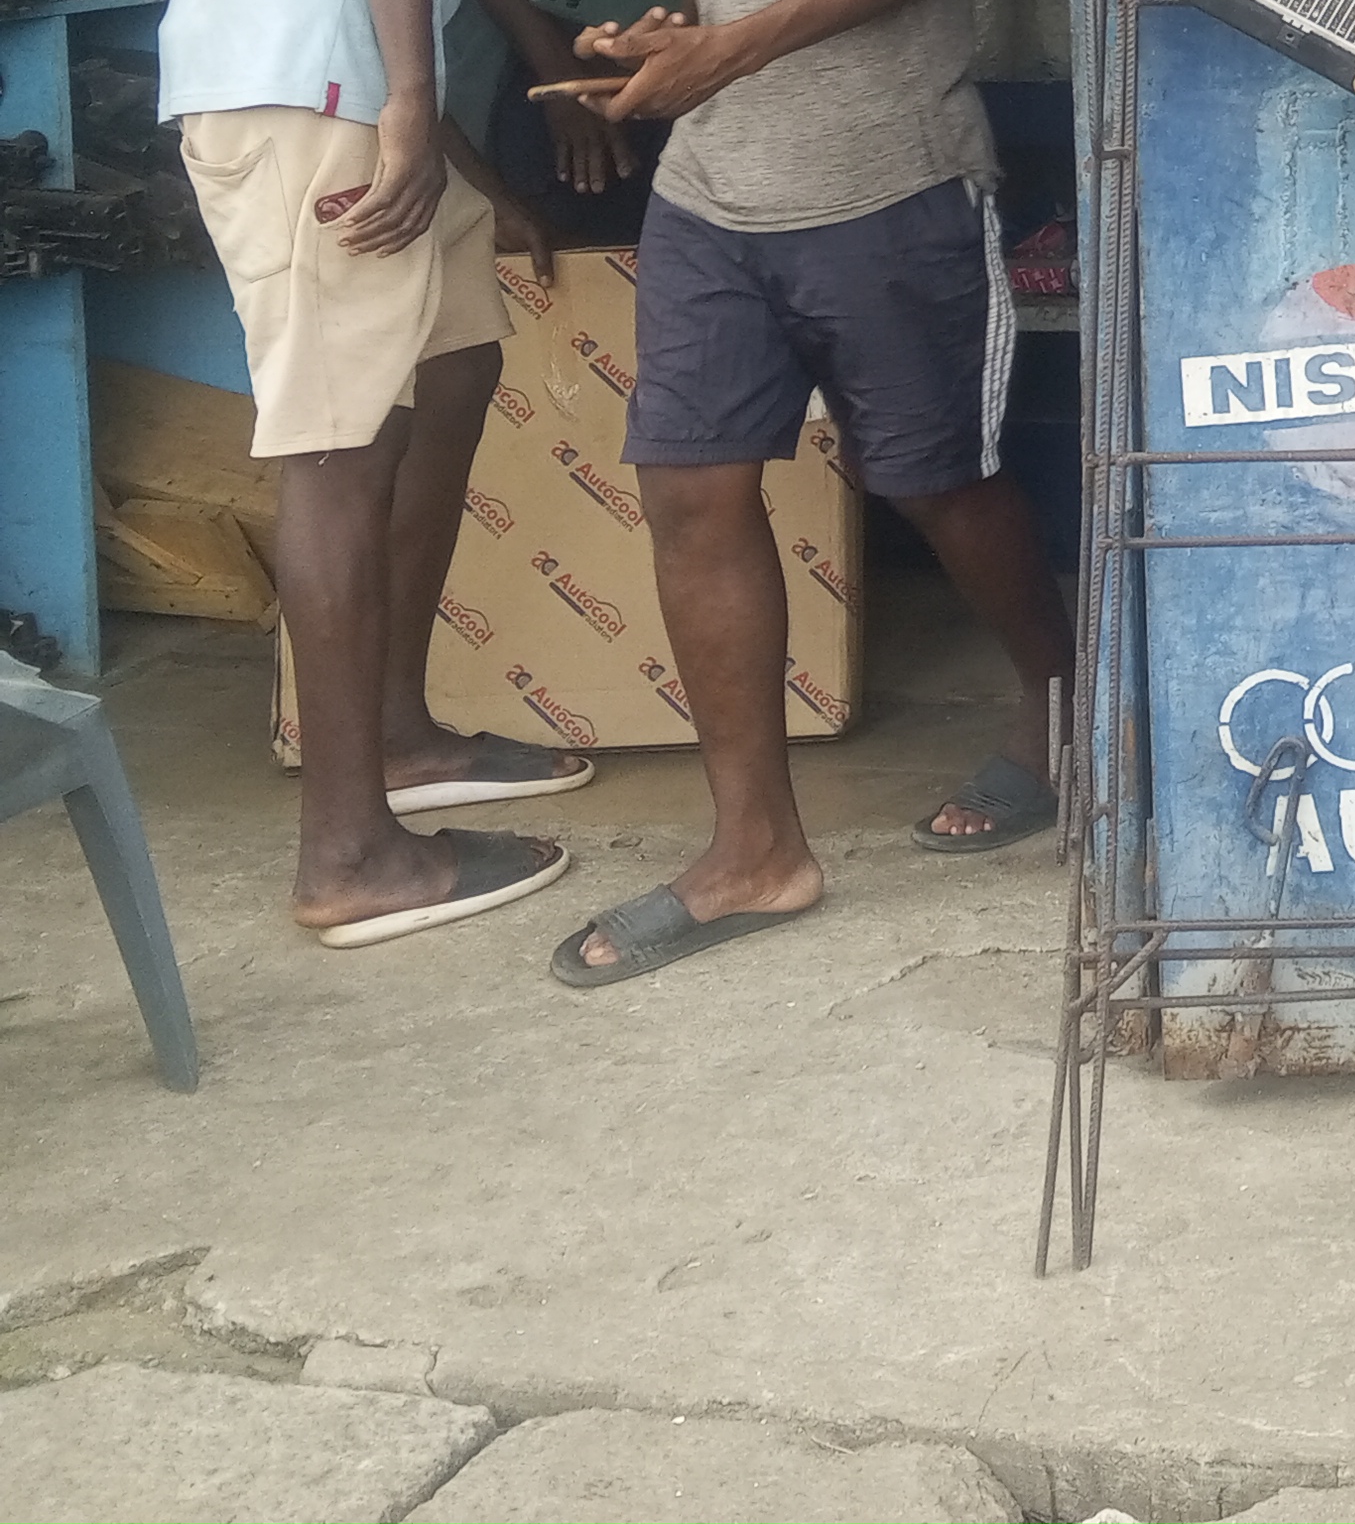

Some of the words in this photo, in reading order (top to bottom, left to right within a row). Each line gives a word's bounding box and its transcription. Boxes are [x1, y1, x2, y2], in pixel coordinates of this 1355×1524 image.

[495, 261, 553, 314] utocool
[595, 352, 637, 390] Auto
[496, 385, 536, 423] cool
[466, 487, 515, 533] tocool
[575, 462, 646, 527] Autocool
[439, 595, 495, 645] tocool
[554, 573, 627, 638] Autocool
[530, 686, 600, 748] Autocool
[793, 671, 846, 722] Autoco
